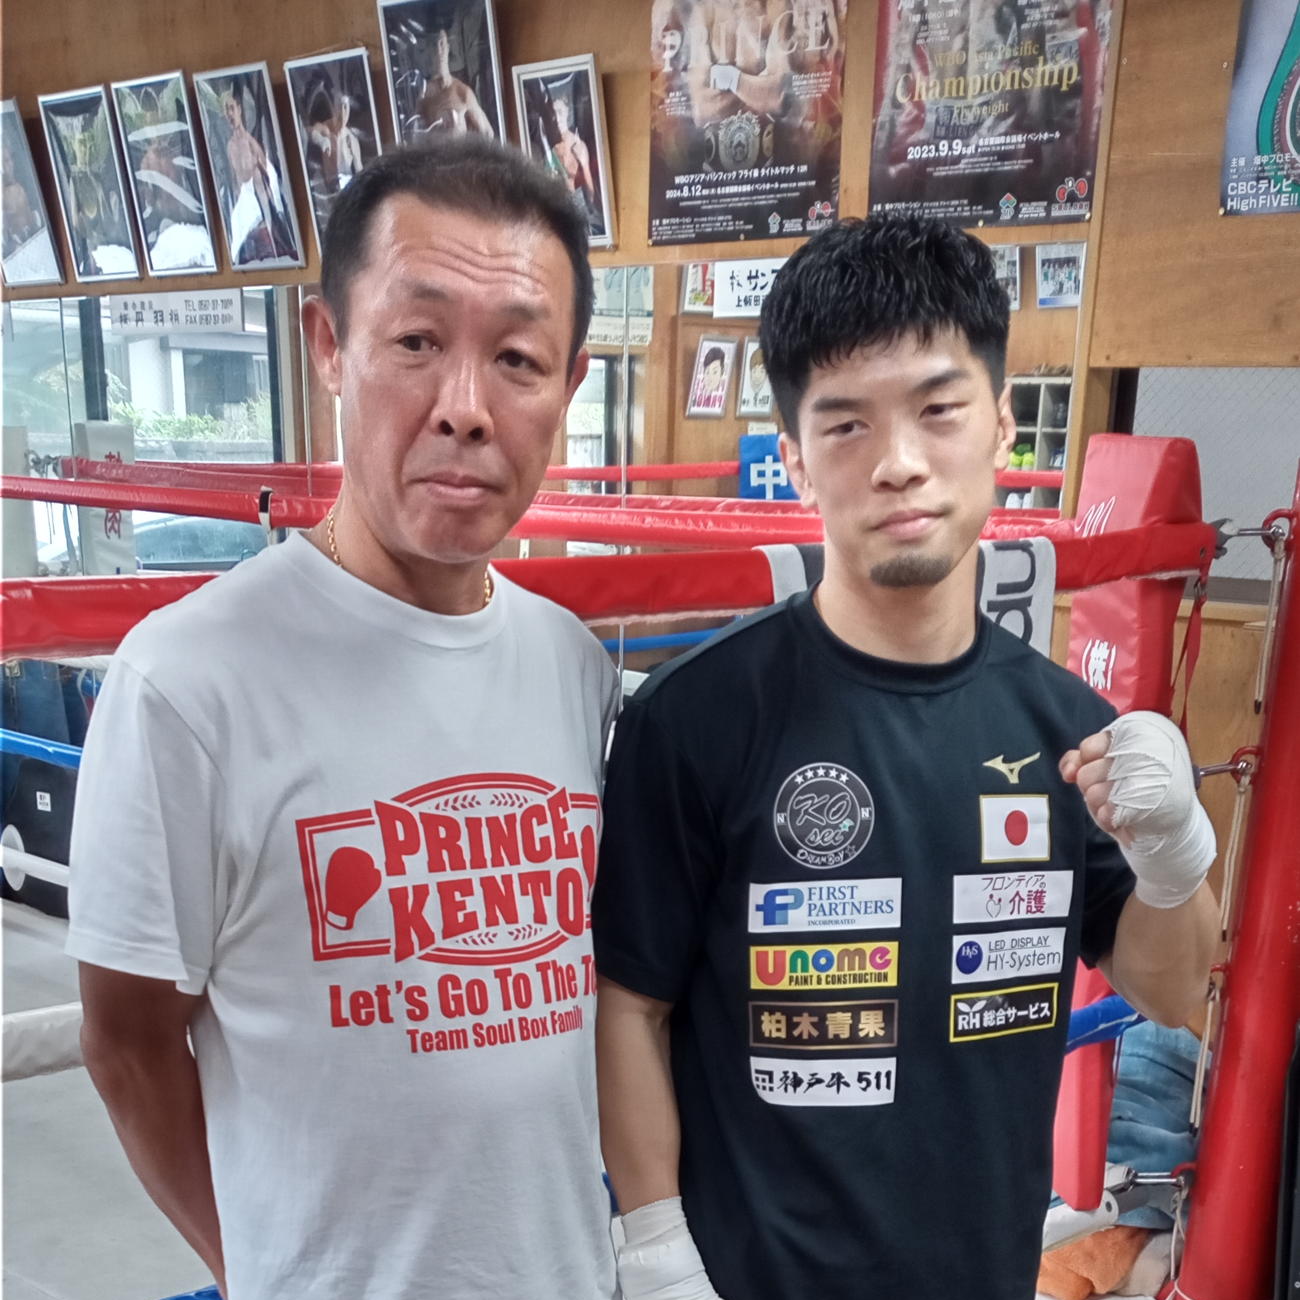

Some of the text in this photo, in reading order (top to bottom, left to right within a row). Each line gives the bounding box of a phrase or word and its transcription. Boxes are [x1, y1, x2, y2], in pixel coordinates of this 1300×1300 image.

[895, 56, 1080, 104] Championship
[750, 455, 788, 500] 中
[374, 786, 580, 877] PRINCE
[807, 885, 859, 901] FIRST
[1009, 889, 1047, 916] 介護
[807, 899, 894, 917] PARTNERS
[807, 919, 856, 927] INCORPORATED
[988, 935, 1050, 952] LED DISPLAY
[986, 950, 1061, 971] HY-System
[437, 973, 489, 1020] Go
[494, 967, 532, 1012] To
[536, 958, 577, 1005] The
[789, 971, 888, 986] PAINT & CONSTRUCTION
[761, 1010, 886, 1040] 柏木青果
[982, 1002, 1051, 1028] 総合サービス
[406, 1005, 583, 1054] Team Soul Box Family
[856, 1069, 892, 1092] 511
